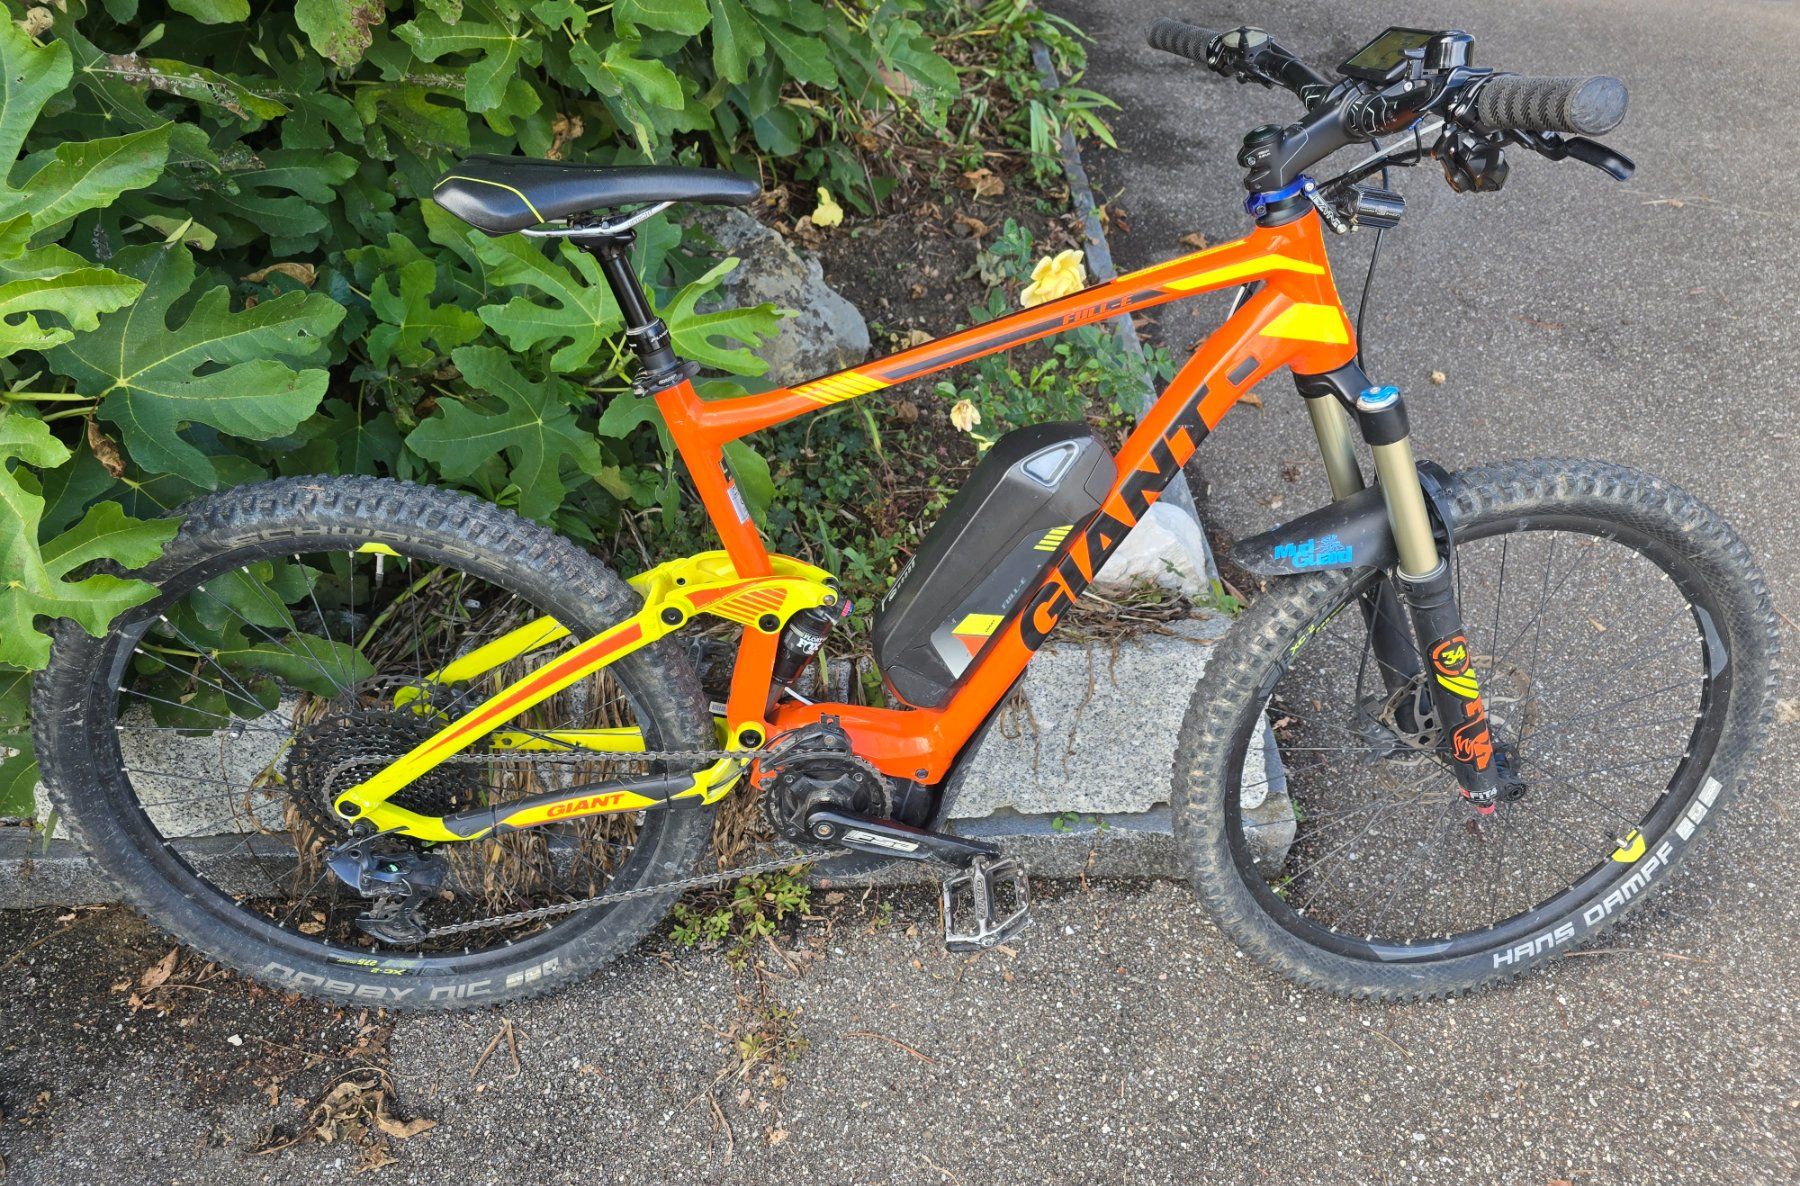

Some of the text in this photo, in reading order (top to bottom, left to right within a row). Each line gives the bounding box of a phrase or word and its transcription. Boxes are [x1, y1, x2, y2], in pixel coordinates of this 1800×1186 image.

[1063, 294, 1134, 326] FULL-E
[1020, 381, 1212, 651] GIANT
[1441, 644, 1466, 665] 34
[547, 793, 625, 817] GIANT
[1493, 841, 1674, 969] HANS DAMPF
[259, 961, 492, 1001] NOBBY NIC
